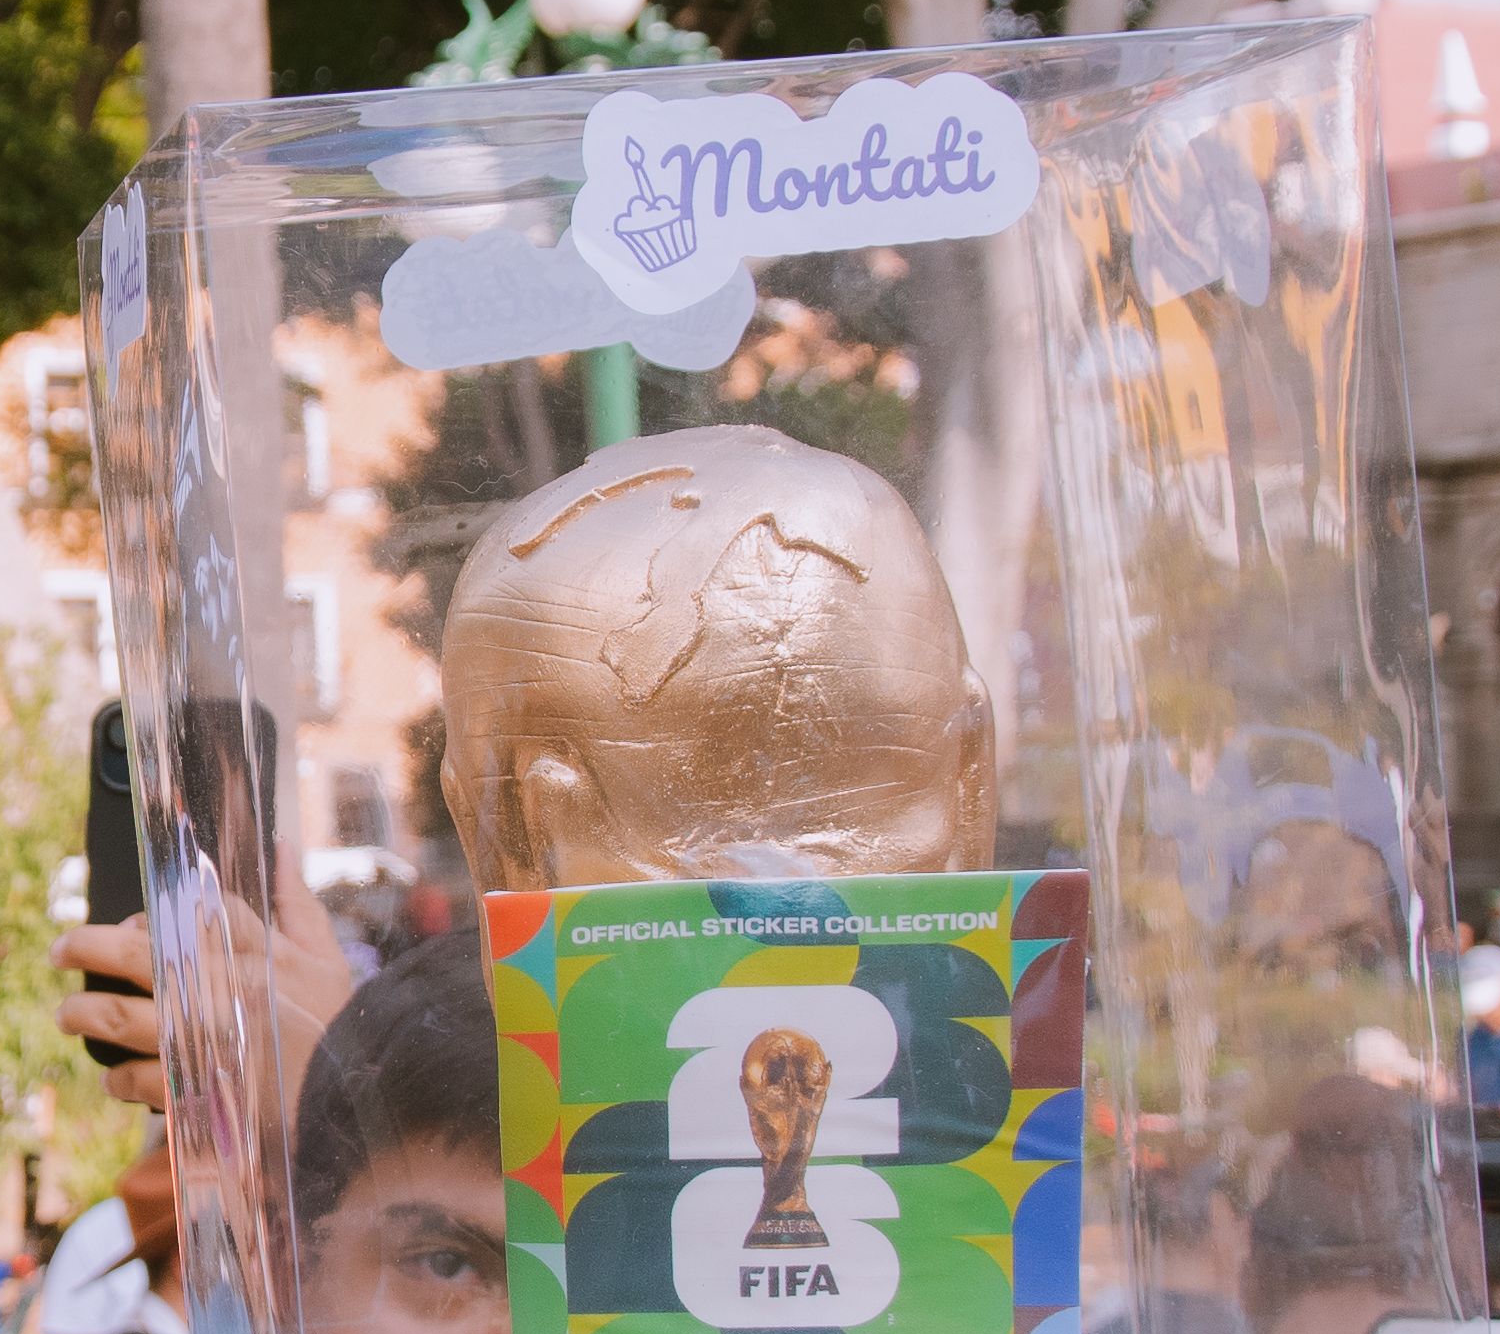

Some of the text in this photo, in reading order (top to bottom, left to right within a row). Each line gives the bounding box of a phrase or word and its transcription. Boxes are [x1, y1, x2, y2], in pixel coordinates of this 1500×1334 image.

[661, 116, 995, 219] Montati
[571, 912, 998, 944] OFFICIAL STICKER COLLECTION
[739, 1264, 839, 1298] FIFA
